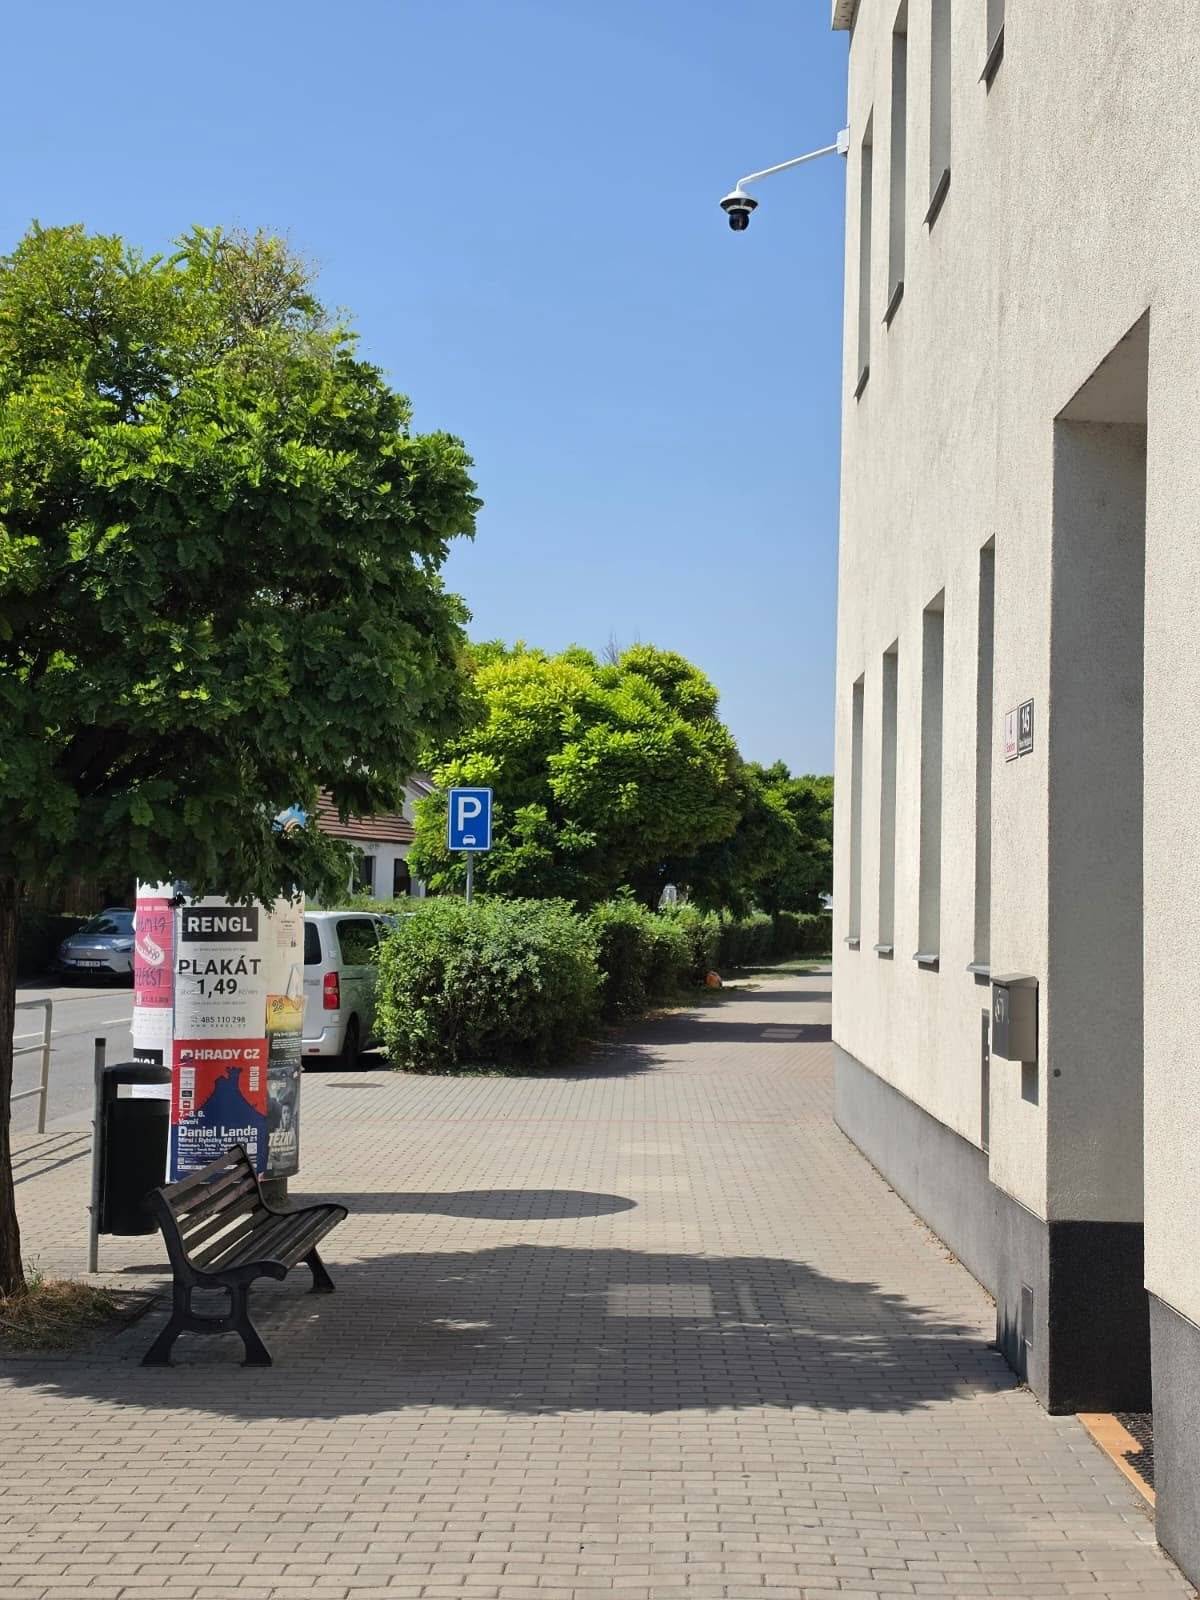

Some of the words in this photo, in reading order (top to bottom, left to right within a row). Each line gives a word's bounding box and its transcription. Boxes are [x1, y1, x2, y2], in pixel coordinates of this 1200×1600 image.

[457, 796, 482, 832] P
[187, 916, 253, 932] RENGL
[178, 955, 261, 975] PLAKÁT
[197, 978, 238, 999] 1,49
[194, 1049, 241, 1060] HRADY
[243, 1049, 260, 1059] CZ
[178, 1126, 217, 1137] Daniel
[220, 1125, 258, 1137] Landa
